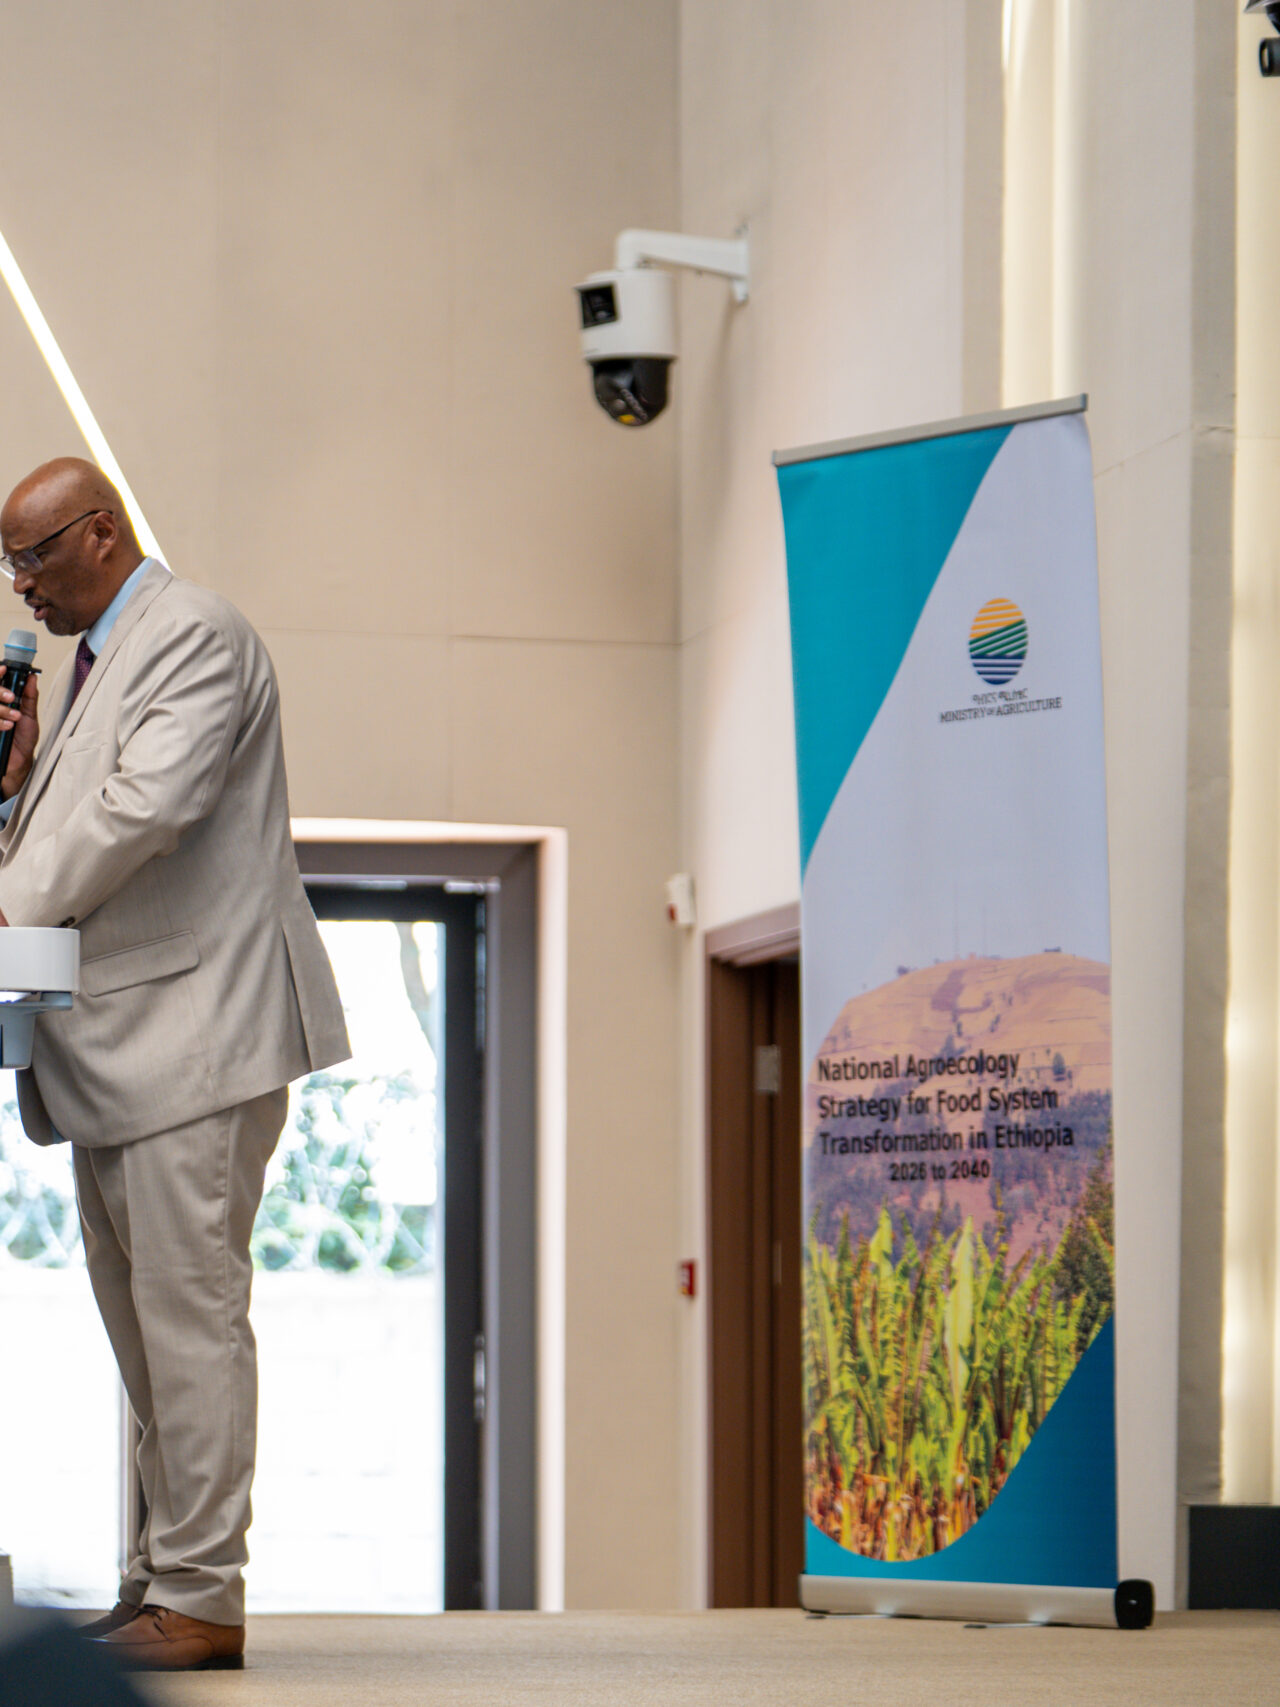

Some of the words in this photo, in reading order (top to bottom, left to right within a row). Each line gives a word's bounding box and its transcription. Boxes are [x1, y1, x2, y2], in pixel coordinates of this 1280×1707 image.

[940, 706, 985, 723] MINISTRY
[996, 697, 1062, 716] AGRICULTURE
[818, 1054, 899, 1081] National
[905, 1049, 1020, 1083] Agroecology
[818, 1095, 901, 1122] Strategy
[907, 1091, 931, 1115] for
[937, 1087, 981, 1113] Food
[988, 1086, 1058, 1117] System
[819, 1129, 963, 1155] Transformation
[969, 1126, 987, 1149] in
[995, 1122, 1074, 1153] Ethiopia
[890, 1162, 926, 1181] 2026
[931, 1162, 946, 1180] to
[951, 1159, 991, 1179] 2040
